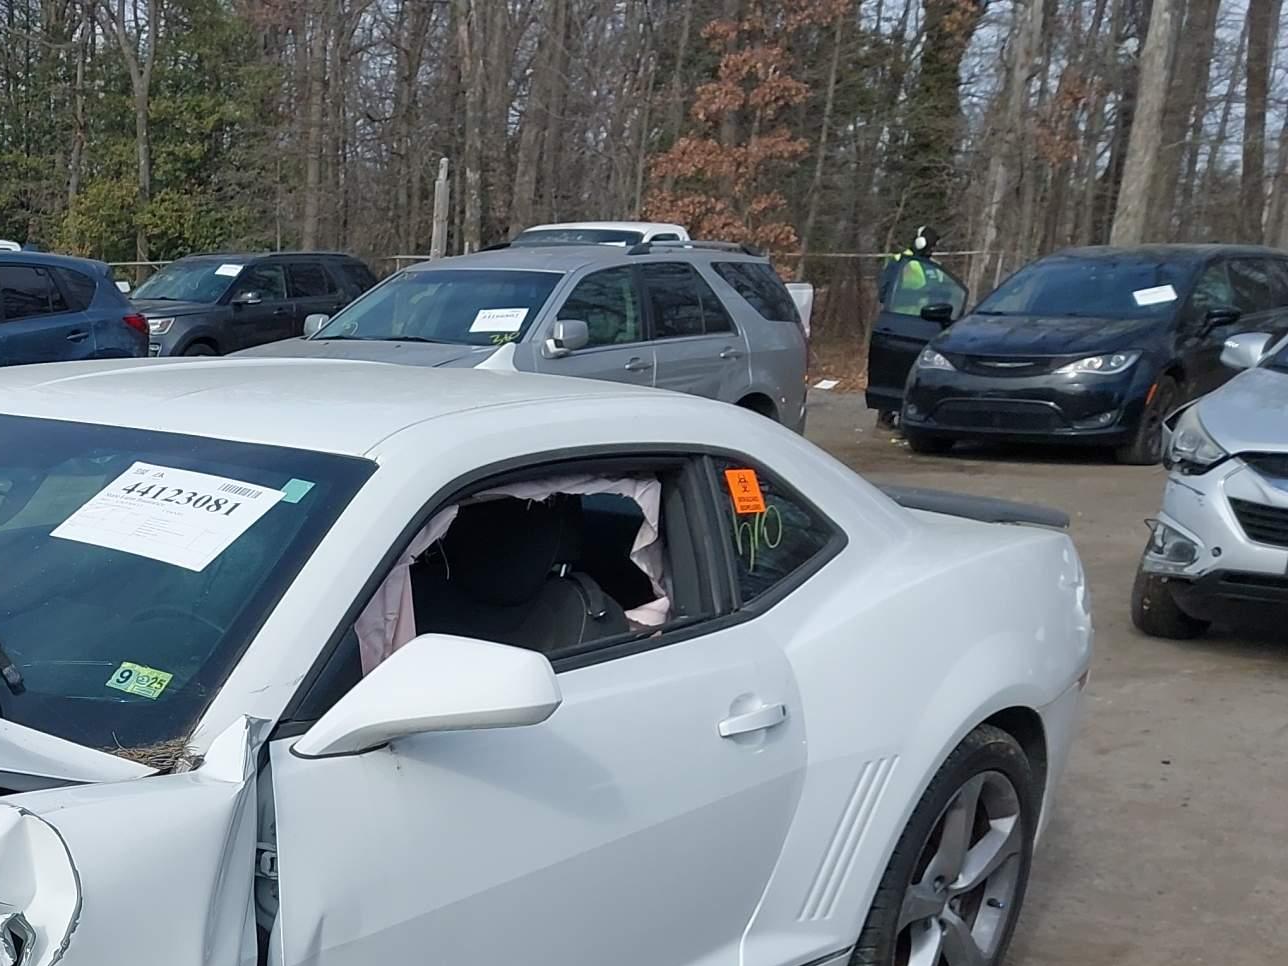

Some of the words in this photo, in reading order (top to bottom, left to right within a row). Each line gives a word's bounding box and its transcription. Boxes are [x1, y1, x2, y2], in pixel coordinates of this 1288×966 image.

[122, 482, 242, 516] 44123081
[116, 669, 133, 684] 9
[147, 676, 166, 690] 25
